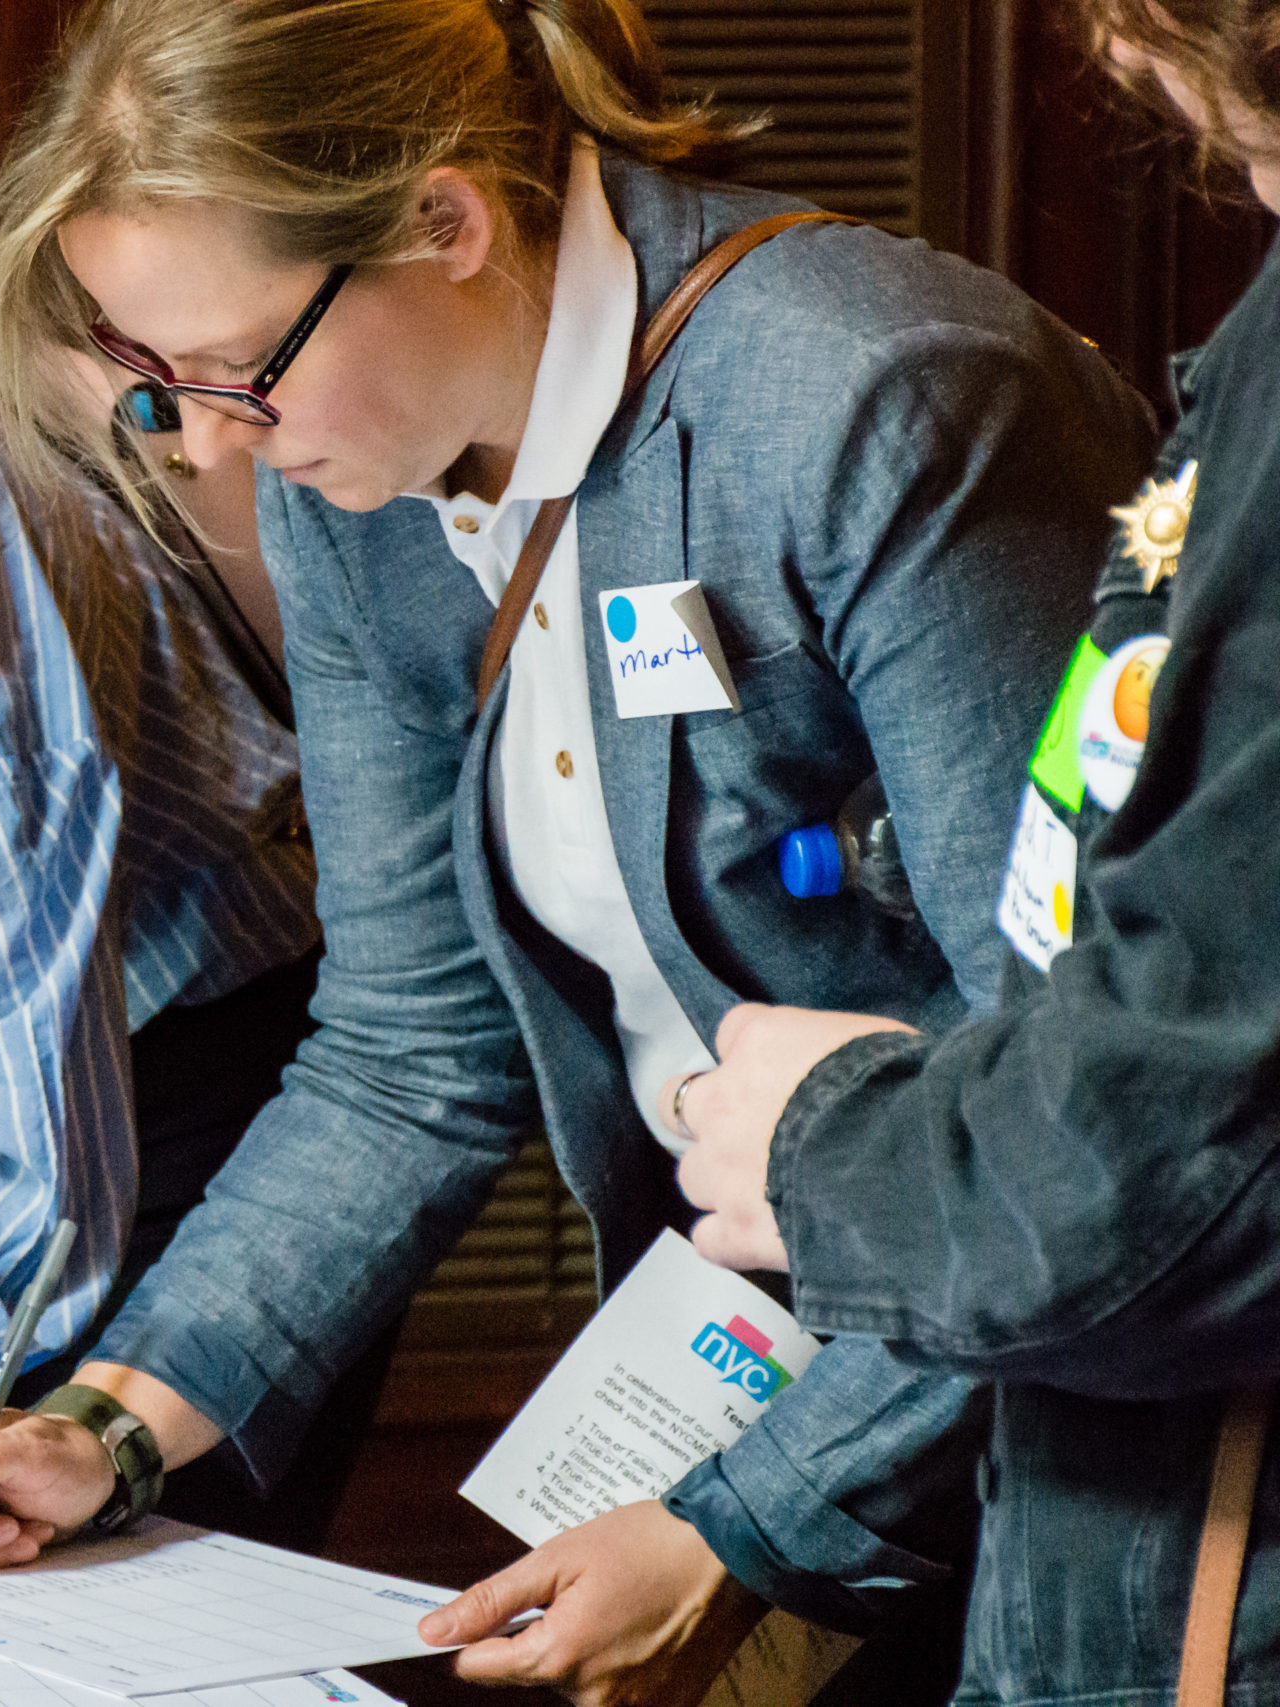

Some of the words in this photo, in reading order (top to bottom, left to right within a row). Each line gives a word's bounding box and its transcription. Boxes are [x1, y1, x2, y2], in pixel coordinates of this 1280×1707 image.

[697, 1326, 771, 1396] nyc
[604, 1377, 626, 1395] dive
[629, 1395, 647, 1411] into
[650, 1409, 666, 1424] the
[669, 1422, 711, 1460] NYCME
[614, 1364, 625, 1375] In
[626, 1374, 681, 1416] celebration
[682, 1415, 695, 1424] of
[695, 1424, 713, 1438] our
[590, 1422, 612, 1445] True
[612, 1443, 626, 1451] or
[595, 1390, 623, 1413] check
[624, 1413, 649, 1430] your
[649, 1430, 691, 1463] answers
[580, 1435, 602, 1457] True
[603, 1456, 615, 1464] or
[560, 1460, 583, 1482] True
[584, 1481, 595, 1490] or
[568, 1449, 621, 1488] Interpreter
[551, 1472, 573, 1495] True
[574, 1494, 586, 1503] or
[530, 1496, 558, 1526] What
